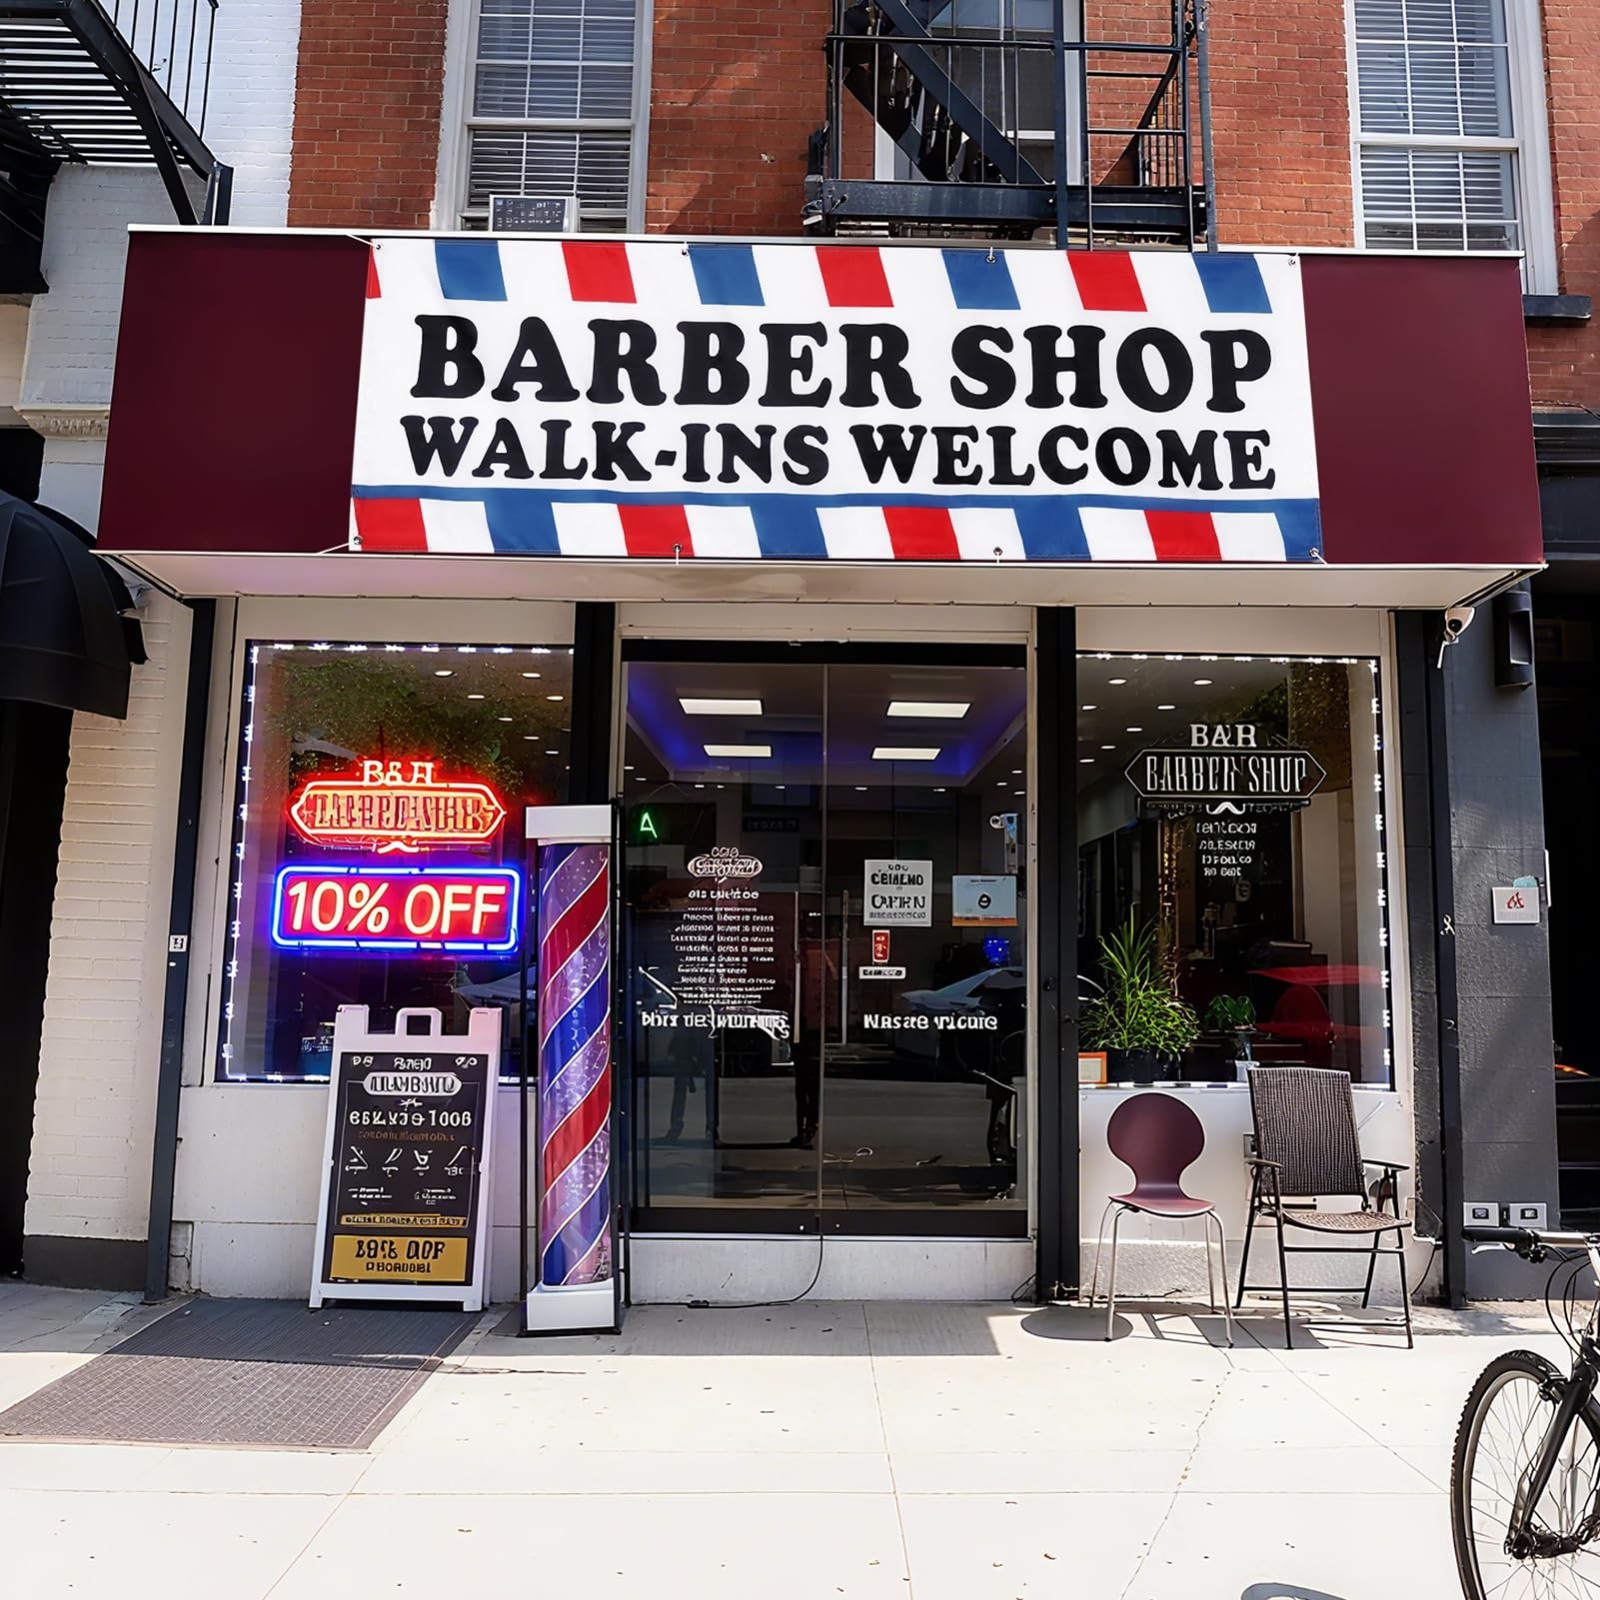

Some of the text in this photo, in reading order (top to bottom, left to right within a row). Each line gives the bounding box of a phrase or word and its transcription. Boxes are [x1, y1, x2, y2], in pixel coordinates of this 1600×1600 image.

[410, 315, 1272, 413] BARBER SHOP
[400, 415, 1276, 490] WALK-INS WELCOME
[288, 881, 506, 935] 10% OFF
